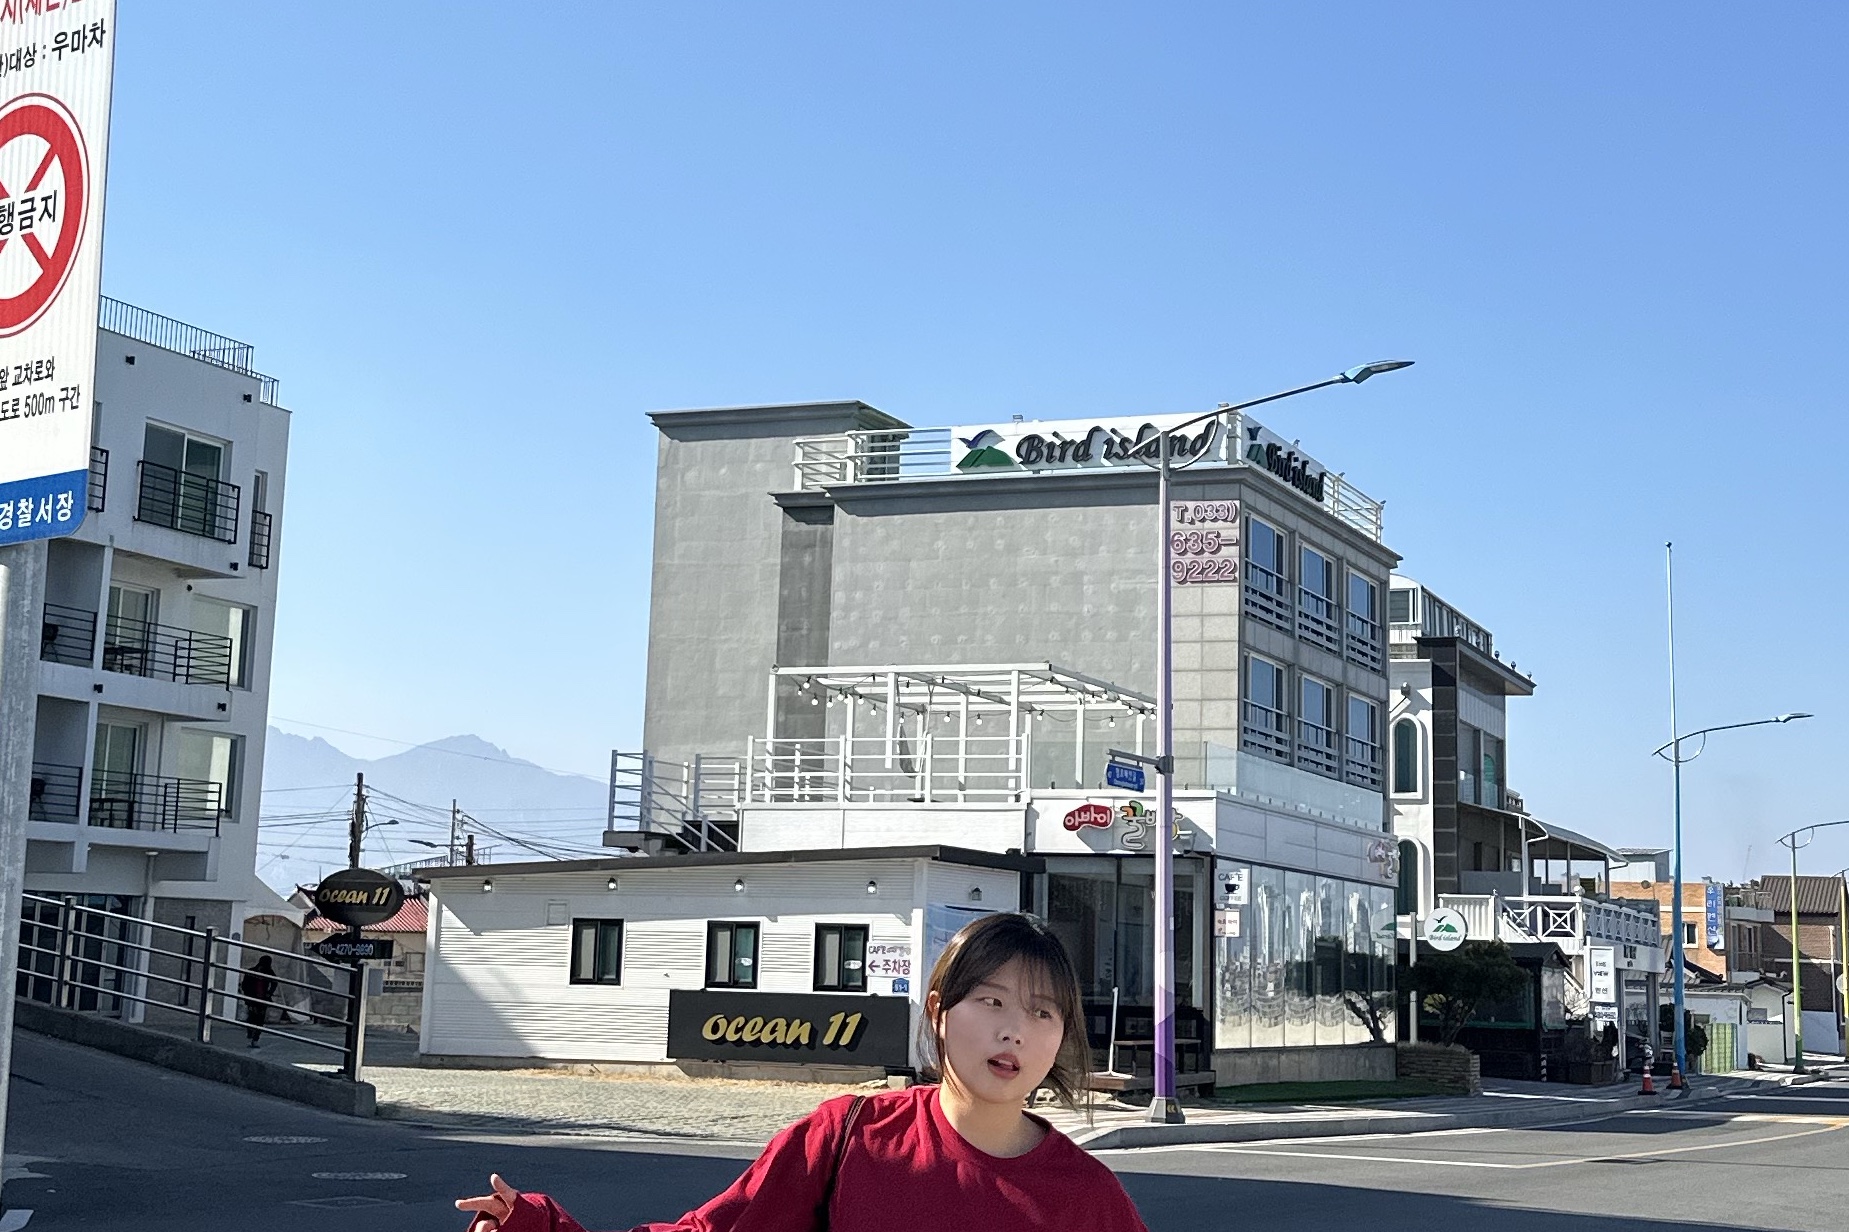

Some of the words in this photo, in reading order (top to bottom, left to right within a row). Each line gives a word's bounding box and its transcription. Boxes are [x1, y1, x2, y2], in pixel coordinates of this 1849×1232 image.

[52, 18, 106, 61] 우마차
[12, 356, 55, 386] 교차로와
[24, 392, 55, 418] 500m
[59, 384, 80, 412] 구간
[1015, 425, 1104, 464] Bird
[1102, 418, 1217, 460] island
[0, 490, 74, 530] 경찰서장
[1172, 502, 1237, 524] T.033)
[1170, 530, 1238, 554] 635-
[1171, 559, 1236, 583] 9222
[1064, 805, 1111, 827] 아바이
[319, 887, 369, 904] ocean
[371, 886, 391, 905] 11
[882, 959, 911, 975] 주차장
[702, 1014, 812, 1045] ocean
[822, 1011, 863, 1046] 11
